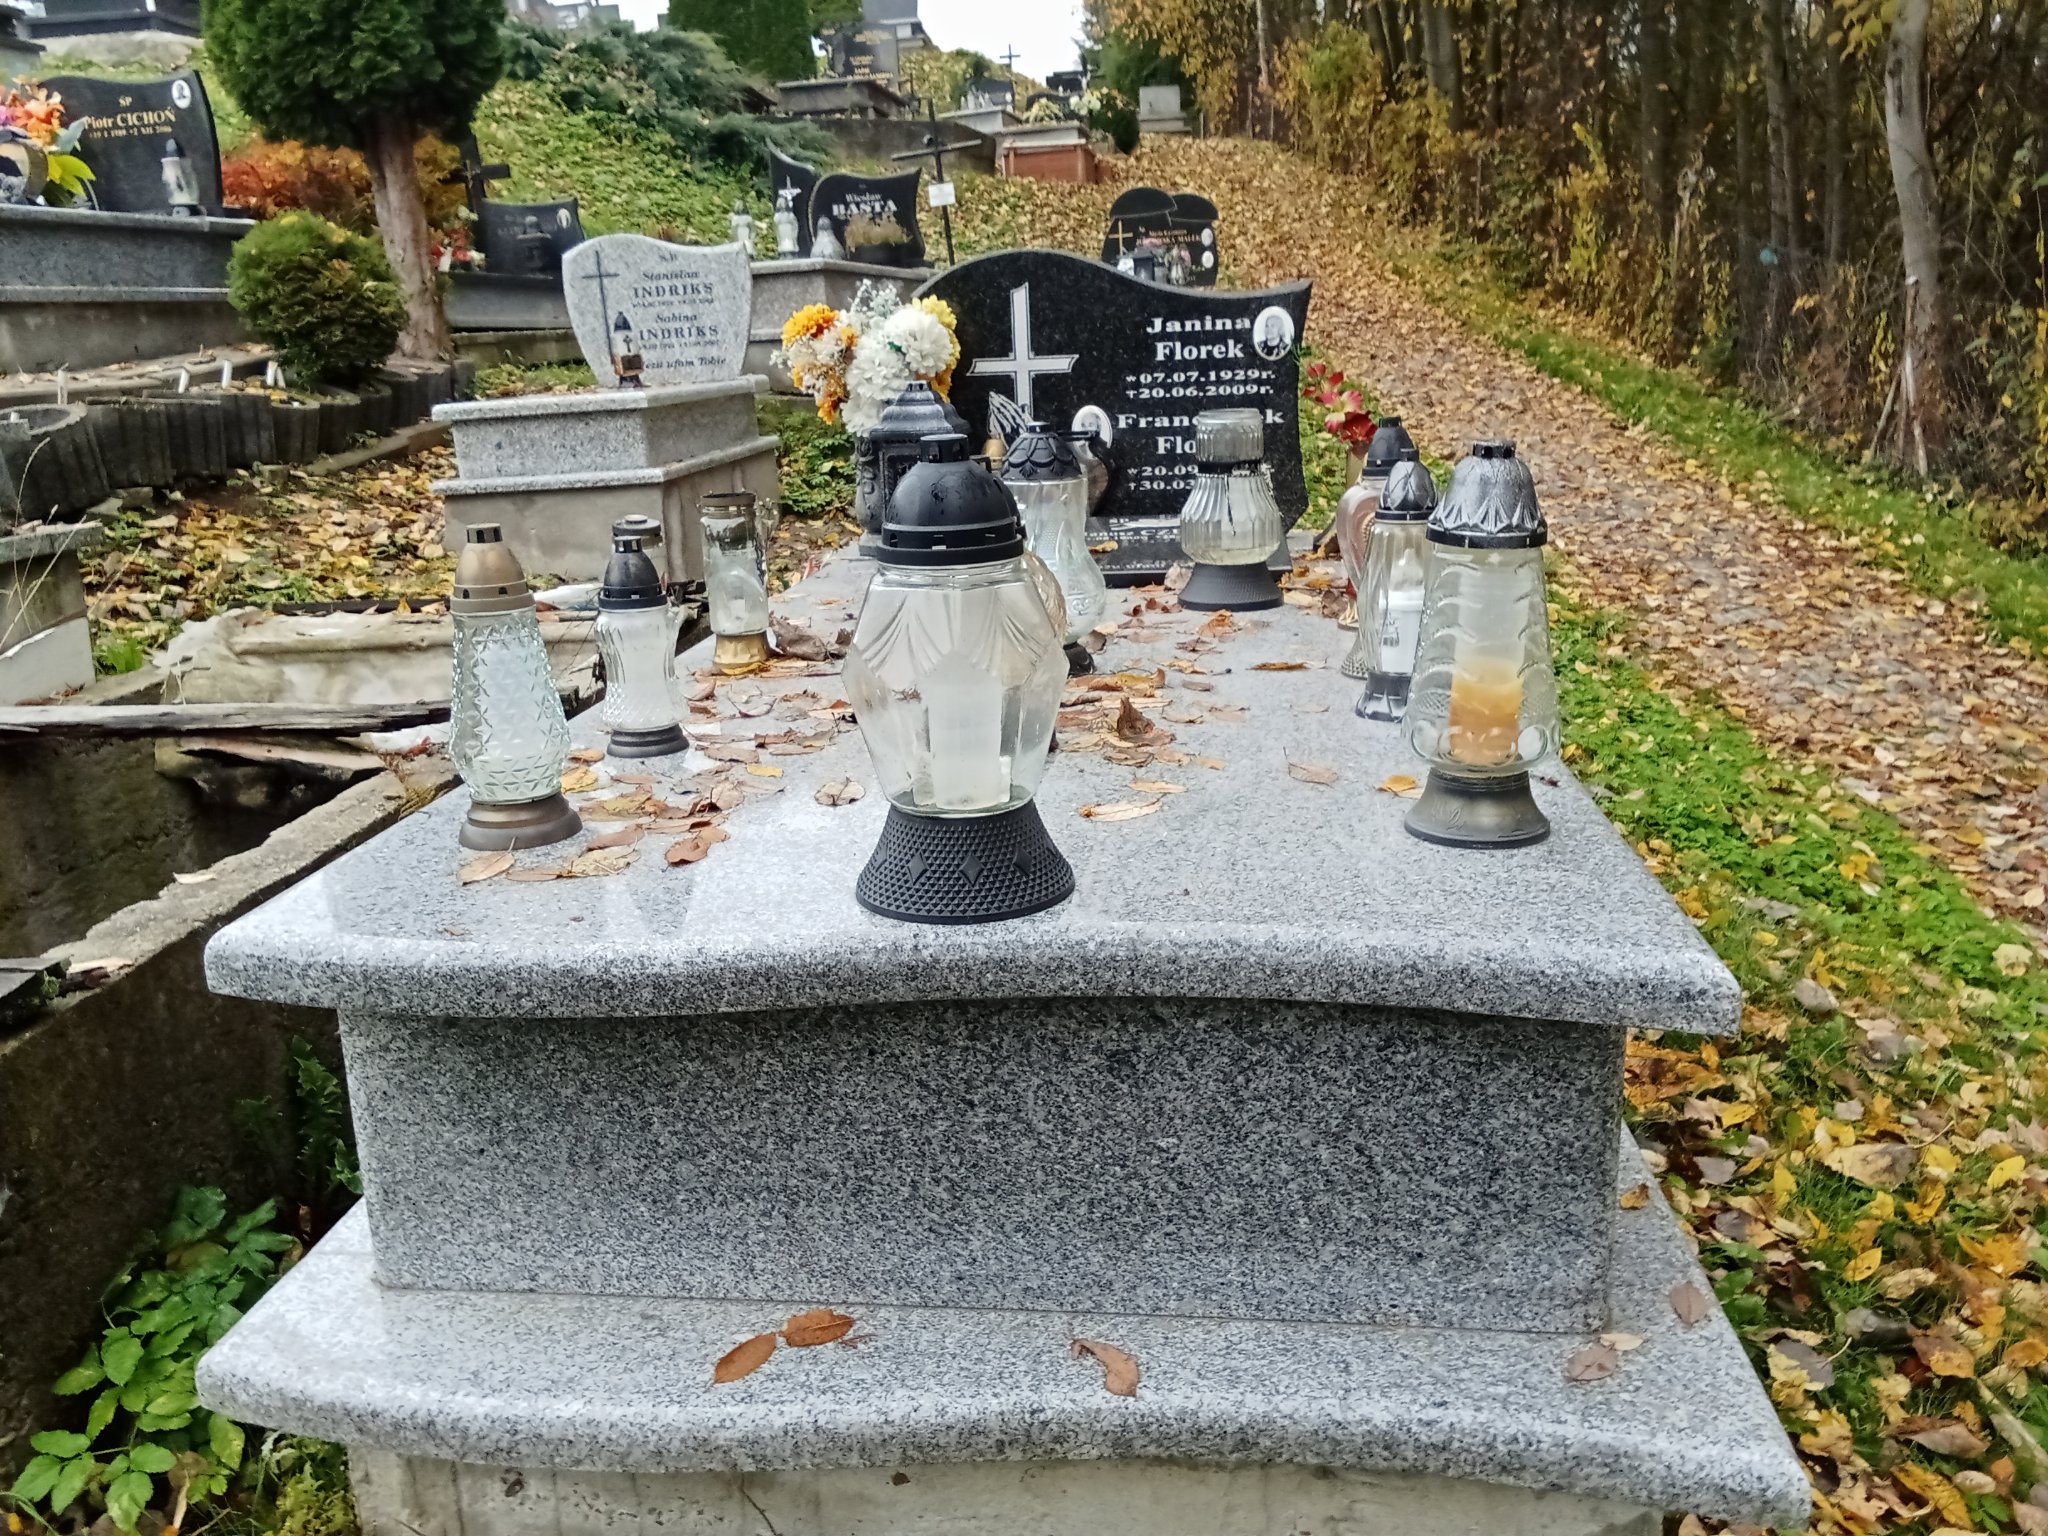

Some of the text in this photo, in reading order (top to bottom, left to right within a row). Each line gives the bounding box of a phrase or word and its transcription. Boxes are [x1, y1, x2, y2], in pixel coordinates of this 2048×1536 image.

[84, 106, 176, 130] Piotr CICHOŃ
[632, 282, 713, 298] INDRIKS
[656, 312, 698, 323] Sabina
[1145, 315, 1251, 334] Janina
[640, 325, 719, 341] INDRIKS
[1154, 339, 1245, 361] Florek
[645, 360, 663, 369] ezu
[1116, 409, 1286, 429] Franck
